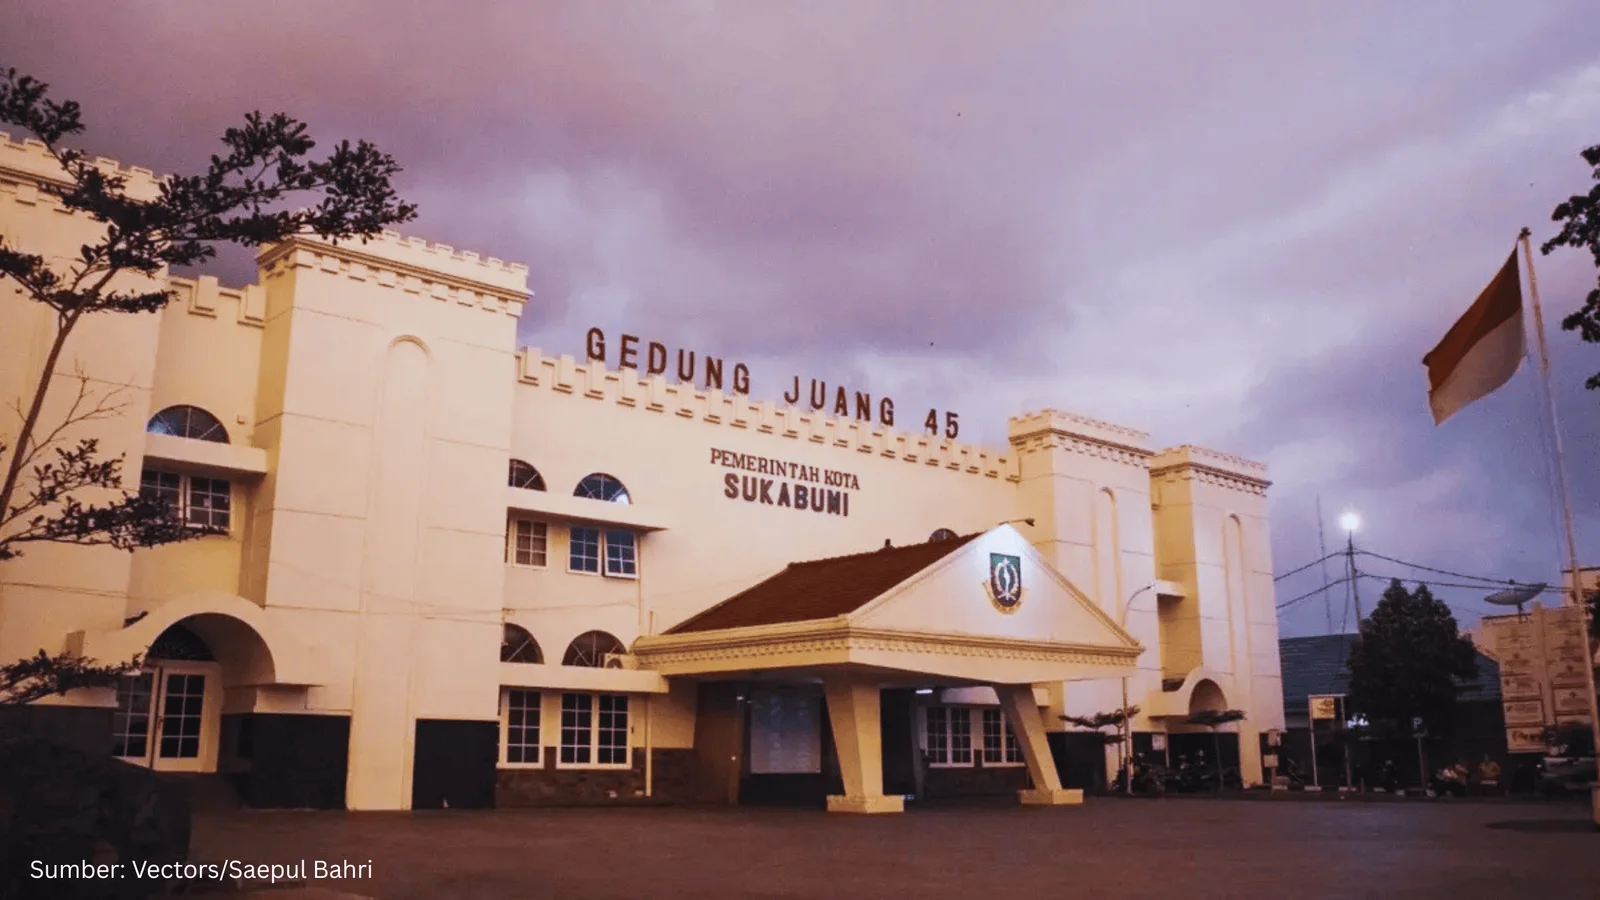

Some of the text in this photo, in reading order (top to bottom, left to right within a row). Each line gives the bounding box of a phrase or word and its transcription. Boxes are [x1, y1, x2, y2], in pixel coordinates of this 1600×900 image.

[587, 327, 959, 439] GEDUNG JUANG 45
[710, 447, 860, 490] PEMERINTAH KOTA
[724, 472, 849, 517] SUKABUMI
